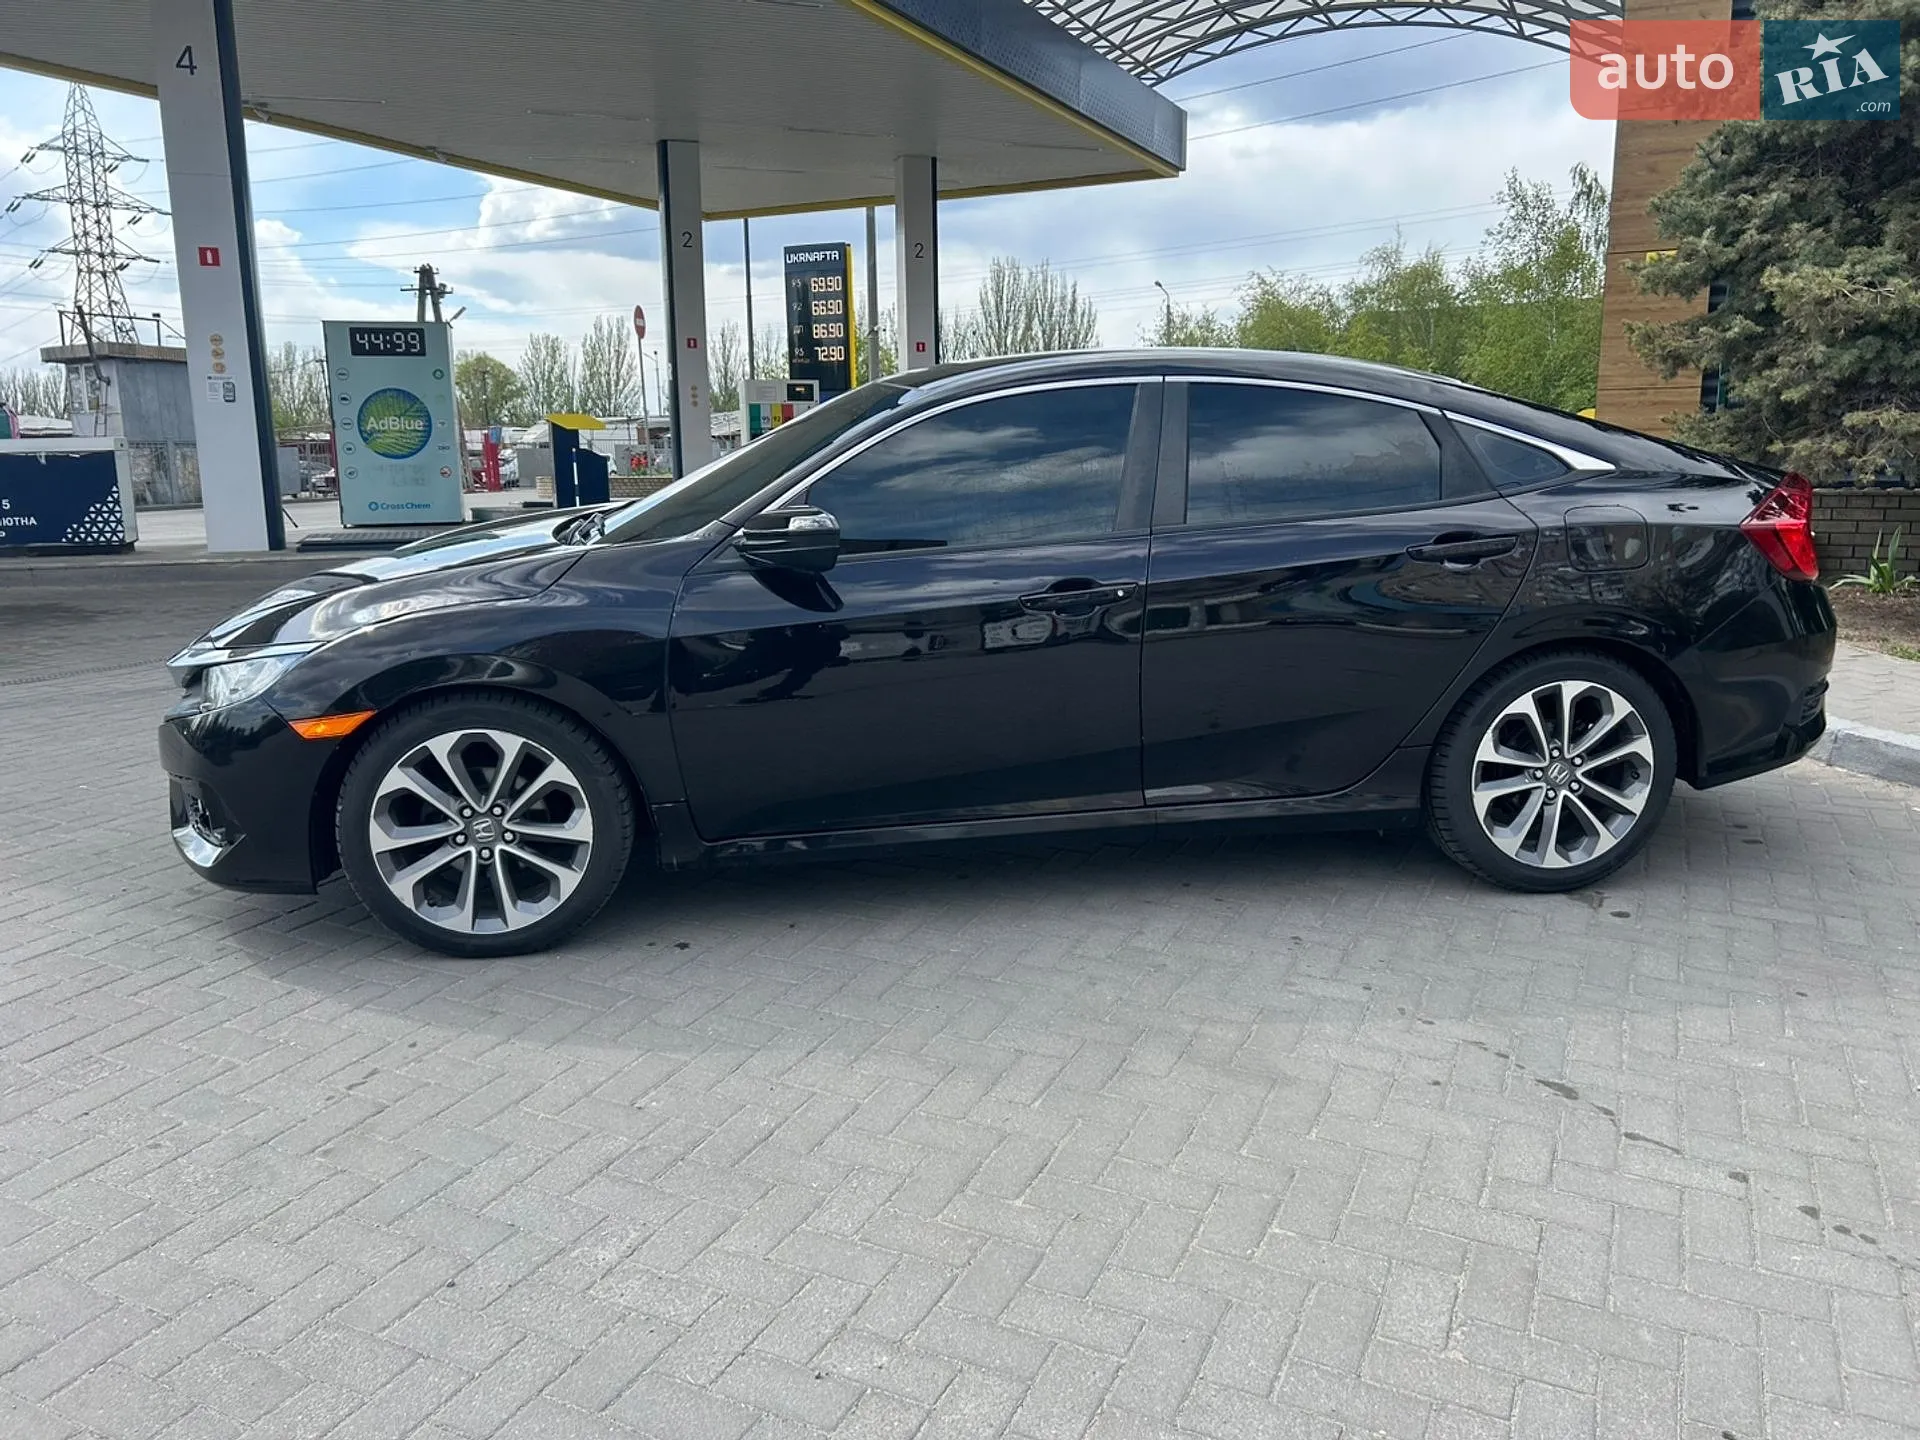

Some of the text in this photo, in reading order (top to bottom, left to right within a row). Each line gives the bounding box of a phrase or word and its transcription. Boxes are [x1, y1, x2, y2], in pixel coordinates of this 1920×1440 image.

[176, 45, 198, 76] 4
[681, 231, 693, 248] 2
[786, 250, 840, 264] UKRNAFTA
[914, 242, 925, 259] 2
[366, 416, 425, 430] AdBlue
[1, 499, 11, 510] 5
[380, 502, 431, 510] CrossChem
